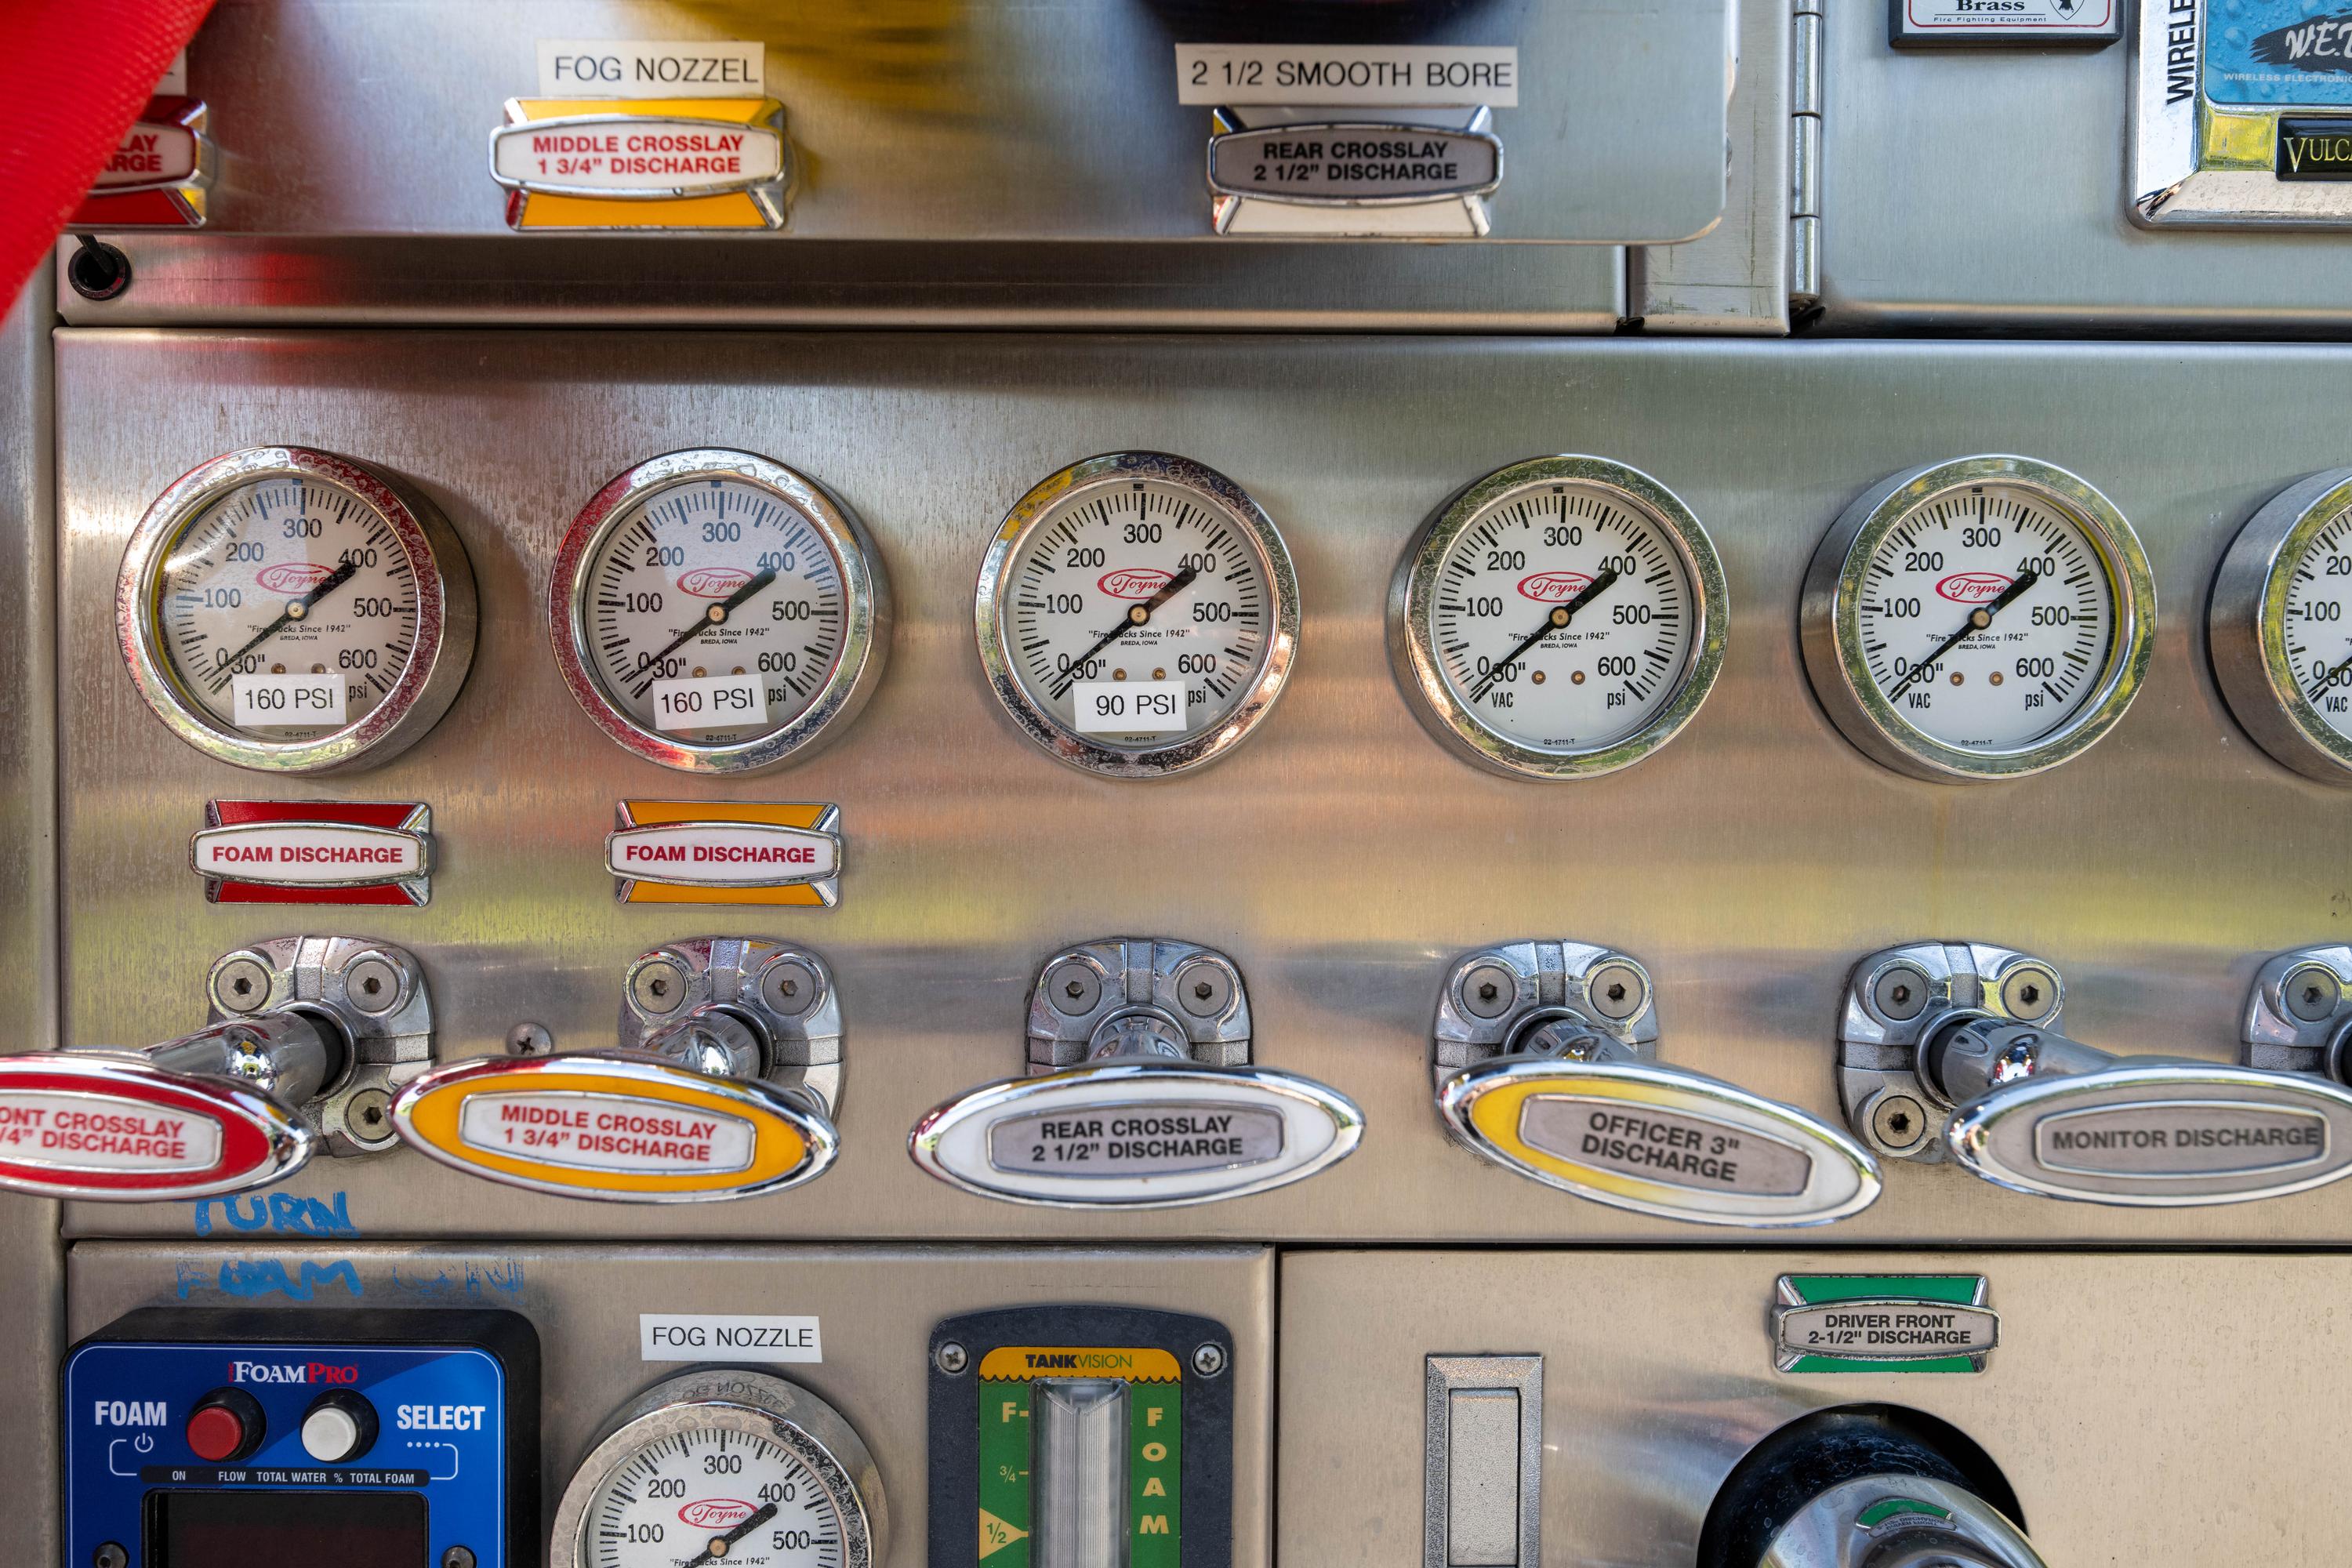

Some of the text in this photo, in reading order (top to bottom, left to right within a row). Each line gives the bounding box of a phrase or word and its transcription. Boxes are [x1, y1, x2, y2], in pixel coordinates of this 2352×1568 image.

[1955, 0, 2025, 11] Brass
[555, 56, 759, 83] FOG NOZZEL
[1192, 60, 1512, 88] 2 1/2 SMOOTH BORE
[2223, 73, 2281, 82] WIRELESS
[532, 135, 745, 154] MIDDLE CROSSLAY
[1264, 141, 1449, 159] REAR CROSSLAY
[2283, 137, 2352, 172] VULC
[537, 159, 547, 175] 1
[611, 157, 741, 174] DISCHARGE
[1254, 164, 1267, 181] 2
[1327, 163, 1458, 180] DISCHARGE
[283, 518, 322, 539] 300
[702, 522, 741, 543] 300
[1123, 524, 1163, 544] 300
[1543, 526, 1583, 547] 300
[1962, 528, 2002, 548] 300
[225, 542, 264, 563] 200
[338, 548, 378, 569] 400
[645, 546, 684, 567] 200
[756, 551, 795, 572] 400
[1066, 547, 1106, 568] 200
[1486, 550, 1526, 572] 200
[1905, 551, 1944, 572] 200
[1178, 553, 1217, 574] 400
[1598, 556, 1637, 577] 400
[2016, 557, 2056, 577] 400
[270, 568, 326, 590] Toyne
[688, 572, 746, 595] Toyne
[1109, 574, 1167, 597] Toyne
[1530, 576, 1588, 600] Toyne
[1949, 577, 2005, 601] Toyne
[205, 587, 241, 608] 100
[353, 597, 393, 618] 500
[626, 592, 662, 613] 100
[1046, 593, 1083, 615] 100
[1466, 597, 1503, 617] 100
[1884, 597, 1921, 619] 100
[772, 600, 811, 621] 500
[1192, 602, 1232, 622] 500
[1612, 604, 1651, 626] 500
[2031, 606, 2070, 626] 500
[2303, 601, 2341, 622] 100
[720, 628, 742, 637] Since
[1139, 630, 1162, 638] Since
[1165, 629, 1190, 637] 1942"
[1559, 632, 1582, 641] Since
[1585, 631, 1610, 641] 1942"
[1977, 633, 2001, 642] Since
[2003, 633, 2029, 641] 1942"
[338, 648, 379, 670] 600
[637, 652, 651, 671] 0
[757, 652, 797, 673] 600
[1057, 652, 1070, 673] 0
[1178, 653, 1217, 674] 600
[1477, 655, 1490, 676] 0
[1597, 656, 1636, 677] 600
[1894, 656, 1907, 677] 0
[2016, 658, 2055, 678] 600
[2313, 660, 2325, 681] 0
[245, 688, 335, 710] 160 PSI
[349, 681, 368, 702] psi
[660, 688, 754, 714] 160 PSI
[768, 684, 787, 706] psi
[1188, 686, 1207, 706] psi
[1491, 691, 1513, 708] VAC
[1607, 688, 1626, 710] psi
[1908, 692, 1931, 709] VAC
[2025, 690, 2044, 710] psi
[1096, 694, 1177, 716] 90 PSI
[2325, 696, 2348, 713] VAC
[212, 845, 403, 863] FOAM DISCHARGE
[626, 845, 815, 864] FOAM DISCHARGE
[54, 1111, 184, 1138] CROSSLAY
[500, 1105, 717, 1140] MIDDLE CROSSLAY
[1041, 1116, 1233, 1140] REAR CROSSLAY
[1588, 1112, 1703, 1151] OFFICER
[42, 1131, 185, 1160] DISCHARGE
[504, 1127, 514, 1145] 1
[578, 1134, 711, 1162] DISCHARGE
[2053, 1127, 2320, 1150] MONITOR DISCHARGE
[1032, 1145, 1046, 1163] 2
[1108, 1138, 1243, 1159] DISCHARGE
[1581, 1134, 1738, 1182] DISCHARGE
[174, 1191, 361, 1239] TURN
[176, 1257, 365, 1301] FOAM
[1825, 1314, 1956, 1329] DRIVER FRONT
[652, 1327, 814, 1348] FOG NOZZLE
[1867, 1330, 1972, 1345] DISCHARGE
[94, 1401, 168, 1426] FOAM
[397, 1404, 486, 1432] SELECT
[703, 1454, 742, 1475] 300
[172, 1471, 416, 1485] ON FLOW TOTAL WATER % TOTAL FOAM
[648, 1479, 686, 1499] 200
[757, 1483, 796, 1504] 400
[691, 1502, 747, 1525] Toyne
[628, 1523, 664, 1544] 100
[772, 1530, 811, 1551] 500
